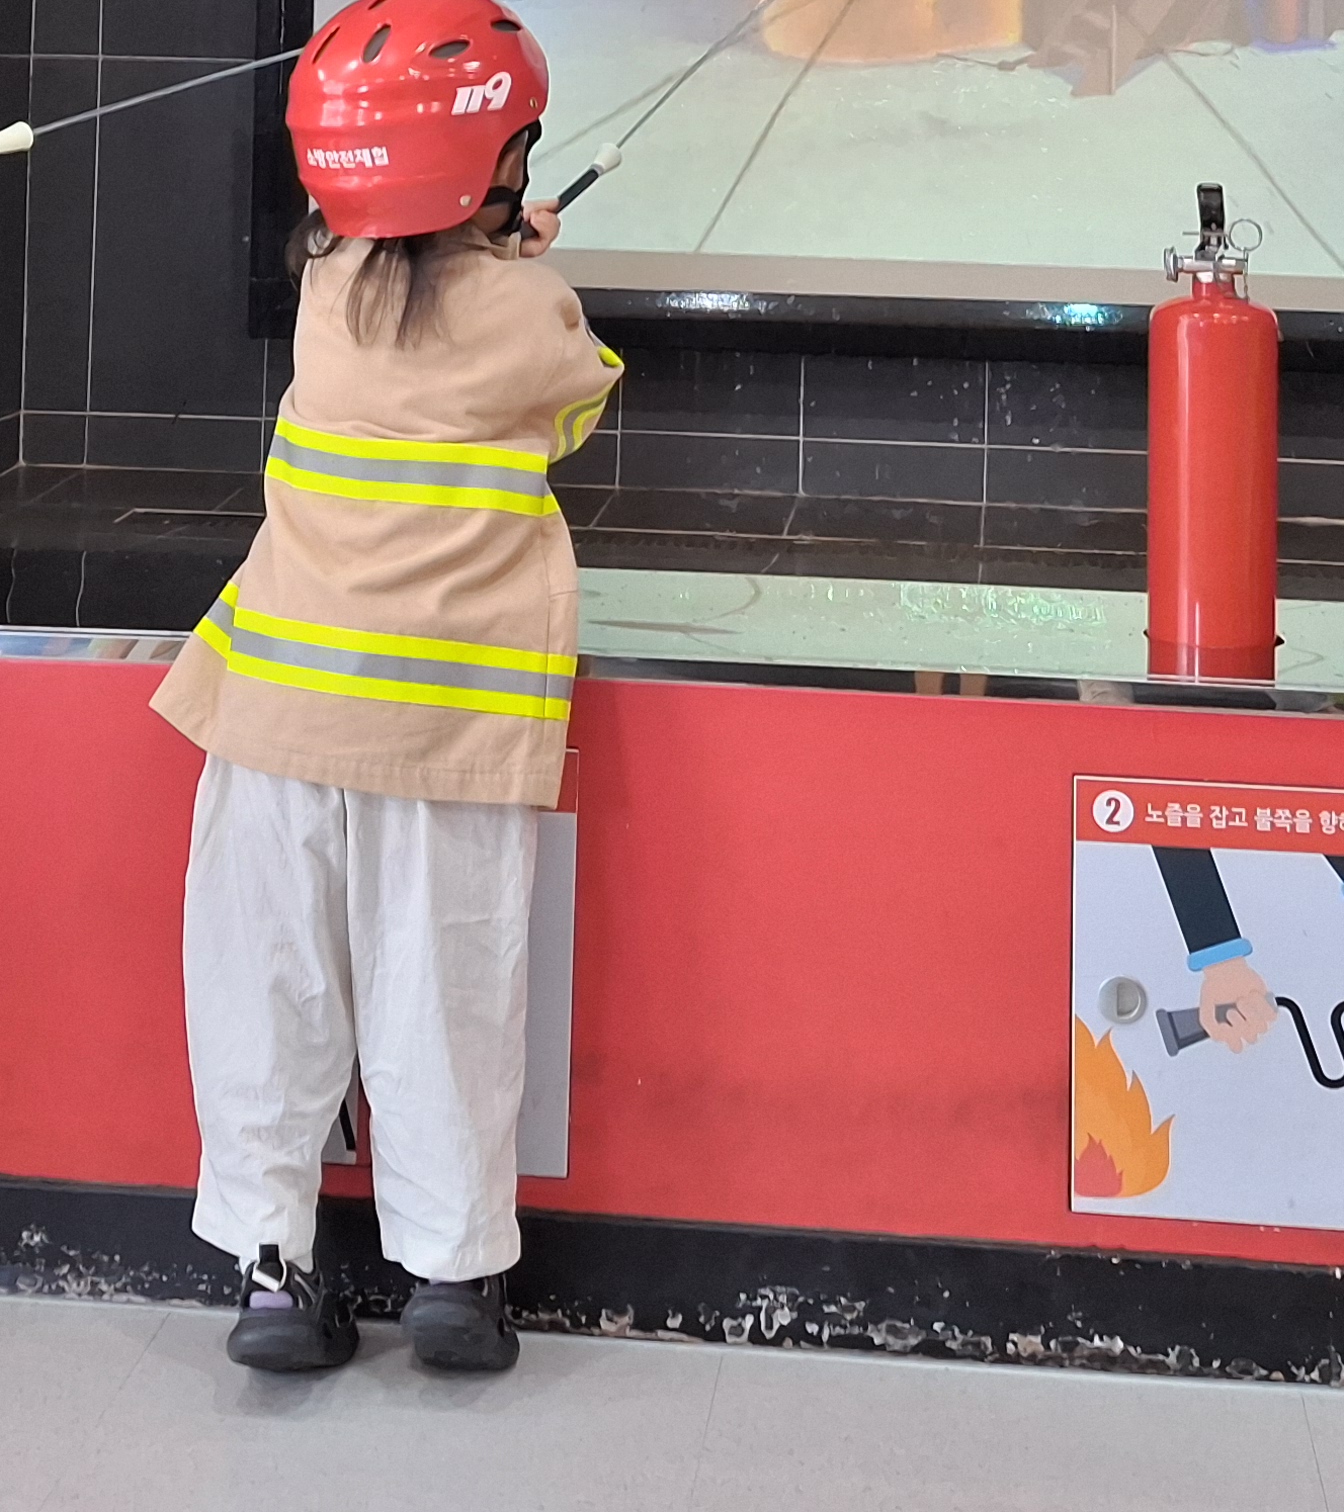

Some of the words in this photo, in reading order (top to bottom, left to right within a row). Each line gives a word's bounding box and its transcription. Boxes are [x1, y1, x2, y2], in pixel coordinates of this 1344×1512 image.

[451, 72, 512, 115] 119
[1105, 797, 1121, 826] 2
[1144, 802, 1204, 828] 노즐을
[1209, 805, 1249, 829] 잡고
[1254, 807, 1313, 834] 불쪽을
